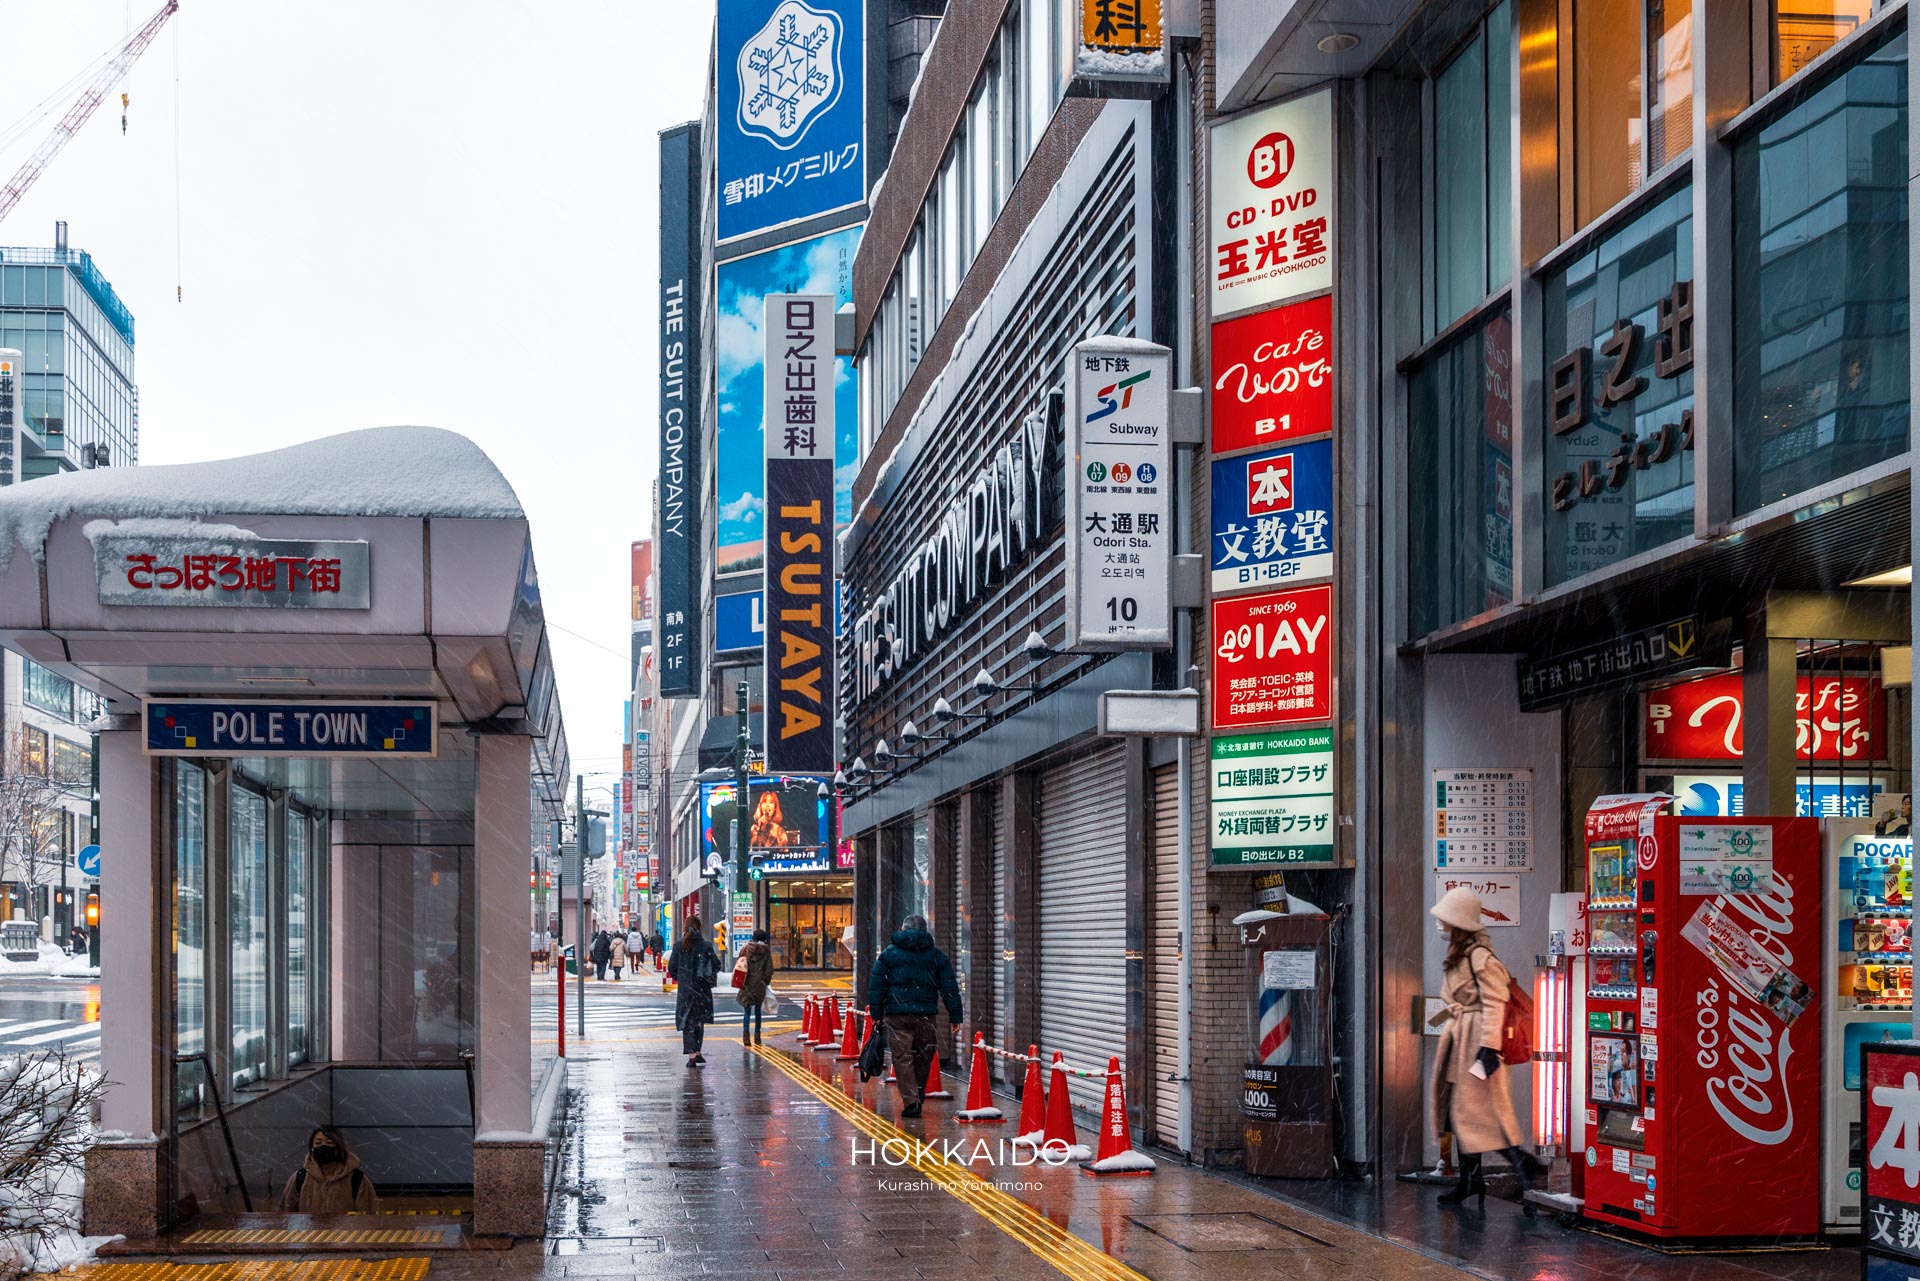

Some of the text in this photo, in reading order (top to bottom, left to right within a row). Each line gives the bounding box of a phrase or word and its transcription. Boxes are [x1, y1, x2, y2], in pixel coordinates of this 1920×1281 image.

[1095, 0, 1147, 43] 科
[1254, 139, 1288, 182] B1
[723, 143, 859, 206] 雪印メグミルク
[1217, 216, 1327, 281] 玉光堂
[1218, 256, 1326, 291] LIFE MUSIC GYOKKODO
[1253, 329, 1324, 363] Café
[1085, 357, 1130, 372] 地下鉄
[784, 301, 817, 457] 日之出歯科
[1215, 358, 1332, 403] ひので
[666, 279, 684, 538] THE SUIT COMPANY
[1109, 423, 1158, 437] Subway
[1255, 414, 1290, 435] B1
[1090, 472, 1153, 482] 07 09 08
[1092, 463, 1151, 473] N T H
[1251, 465, 1290, 506] 本
[1085, 512, 1159, 534] 大通駅
[855, 600, 881, 705] THE
[923, 392, 1060, 642] COMPANY
[1093, 537, 1151, 547] Odori Sta.
[1215, 510, 1329, 566] 文教堂
[1105, 553, 1140, 564] 大通站
[127, 554, 341, 593] さっぽろ地下街
[1101, 568, 1145, 579] 오도리역
[666, 611, 684, 626] 南角
[780, 500, 822, 740] TSUTAYA
[1106, 597, 1137, 621] 10
[1248, 601, 1297, 616] SINCE 1969
[667, 634, 683, 647] 2F
[668, 656, 683, 669] 1F
[213, 711, 367, 745] POLE TOWN
[1227, 737, 1330, 752] 北海道銀行 HOKKAIDO BANK
[1218, 763, 1328, 787] 口座開設プラザ
[1218, 813, 1329, 836] 外貨両替プラザ
[1604, 812, 1624, 826] Coke
[1733, 838, 1750, 847] 100
[1241, 849, 1304, 861] 日の出ビル B2
[1733, 874, 1750, 883] 100
[1110, 1083, 1124, 1137] 落雪注意
